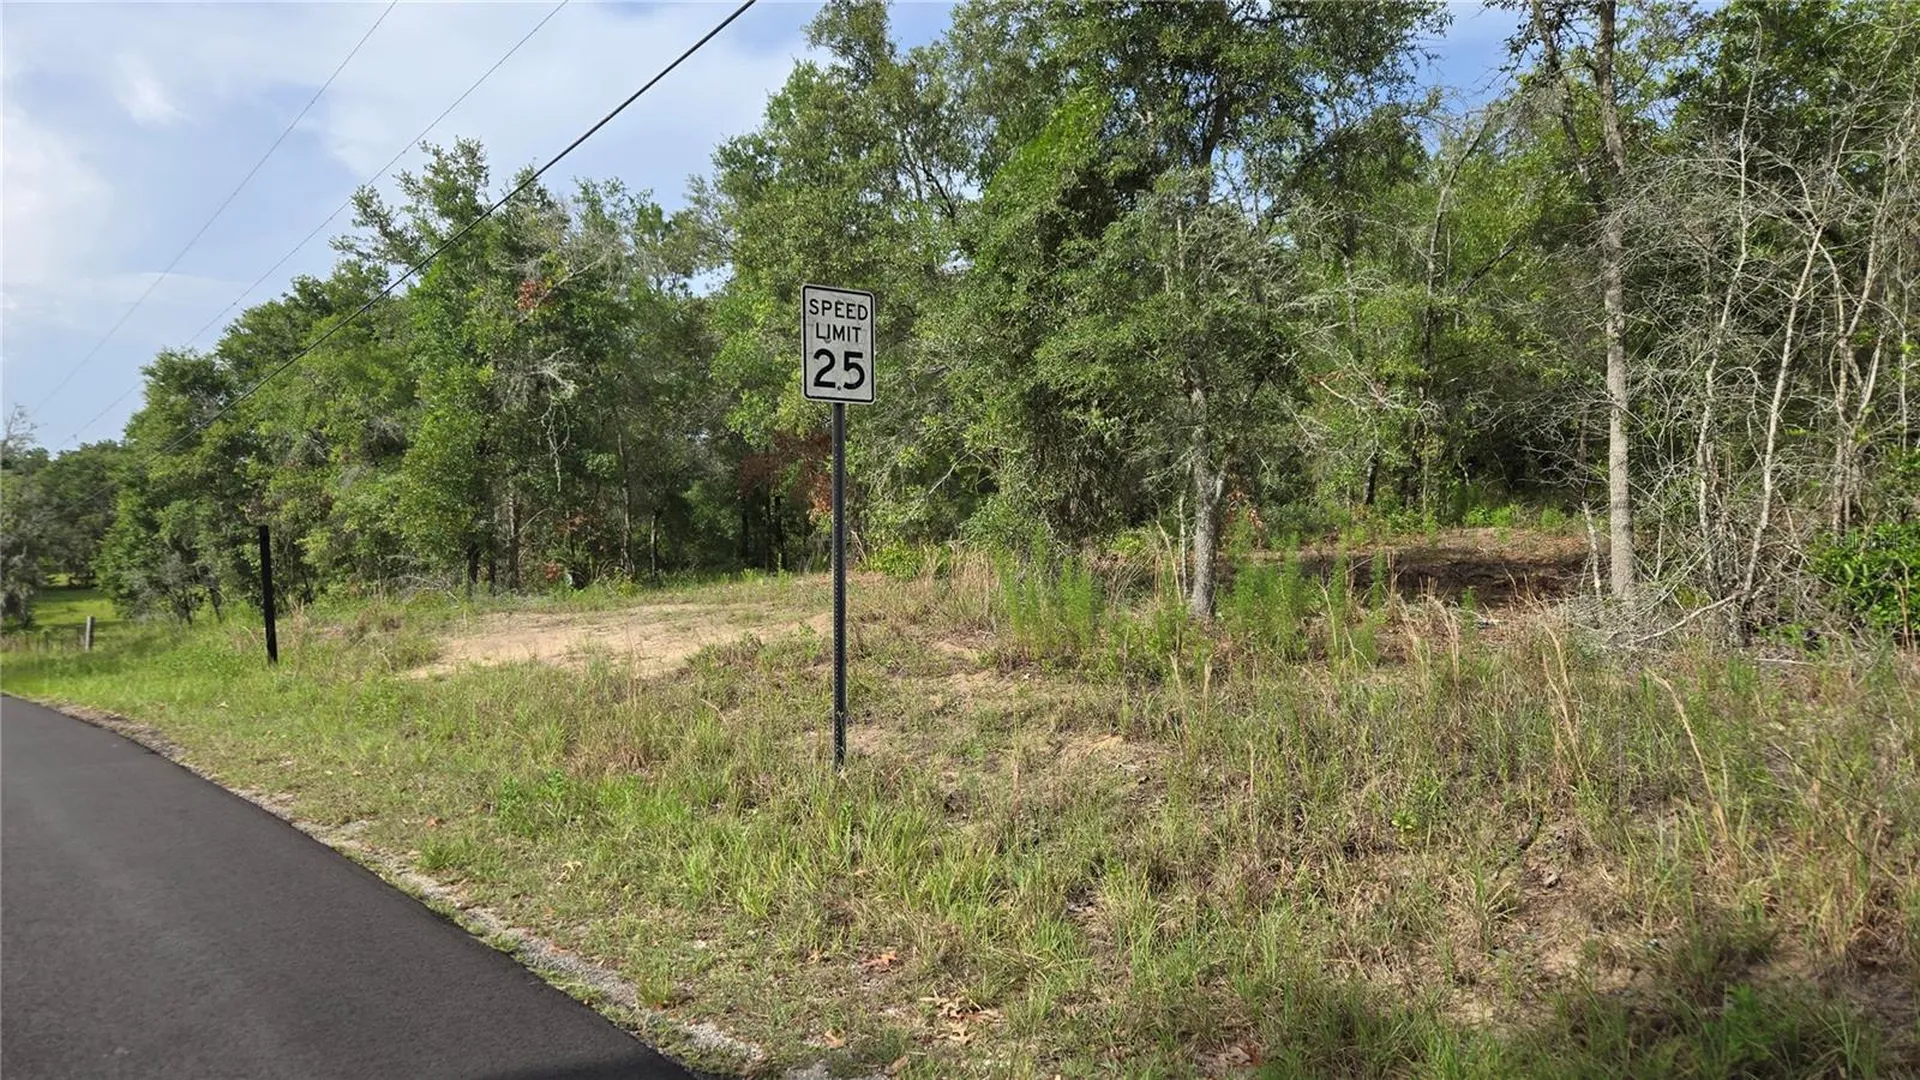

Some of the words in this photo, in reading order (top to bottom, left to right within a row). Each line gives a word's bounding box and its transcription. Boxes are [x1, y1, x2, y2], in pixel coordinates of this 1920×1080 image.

[809, 298, 868, 321] SPEED
[816, 322, 861, 343] LIMIT
[813, 348, 865, 390] 25
